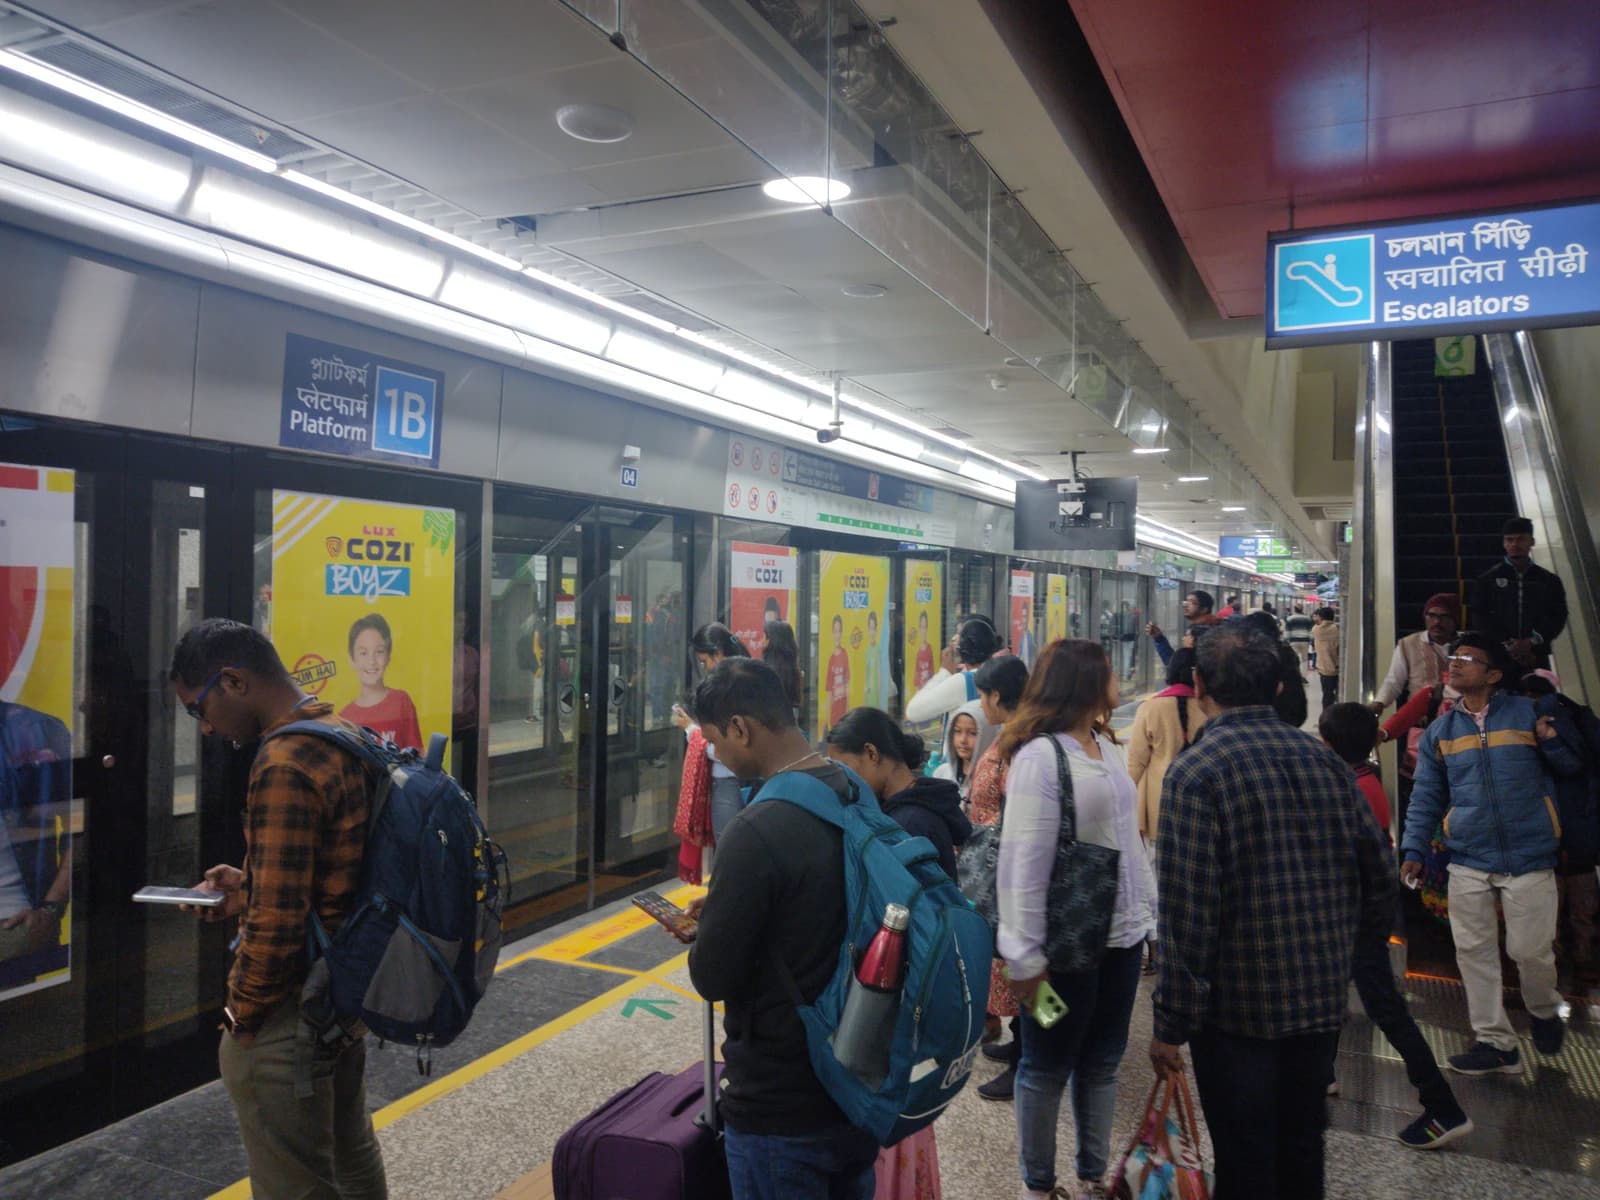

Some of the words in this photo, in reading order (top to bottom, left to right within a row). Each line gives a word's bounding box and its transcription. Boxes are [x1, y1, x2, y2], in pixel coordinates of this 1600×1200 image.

[1384, 231, 1466, 258] চলমান
[1471, 218, 1533, 251] সিঁড়ি
[1384, 256, 1506, 290] स्वचालित
[1518, 243, 1589, 278] सीढ़ी
[1383, 294, 1530, 323] Escalators
[295, 383, 368, 419] प्लेटफार्म
[383, 388, 426, 440] 1B
[290, 409, 367, 442] Platform
[623, 469, 636, 485] 04
[362, 525, 396, 537] LUX
[346, 538, 411, 563] COZI
[330, 564, 406, 604] BOYZ
[755, 568, 783, 584] COZI
[849, 575, 870, 589] COZI
